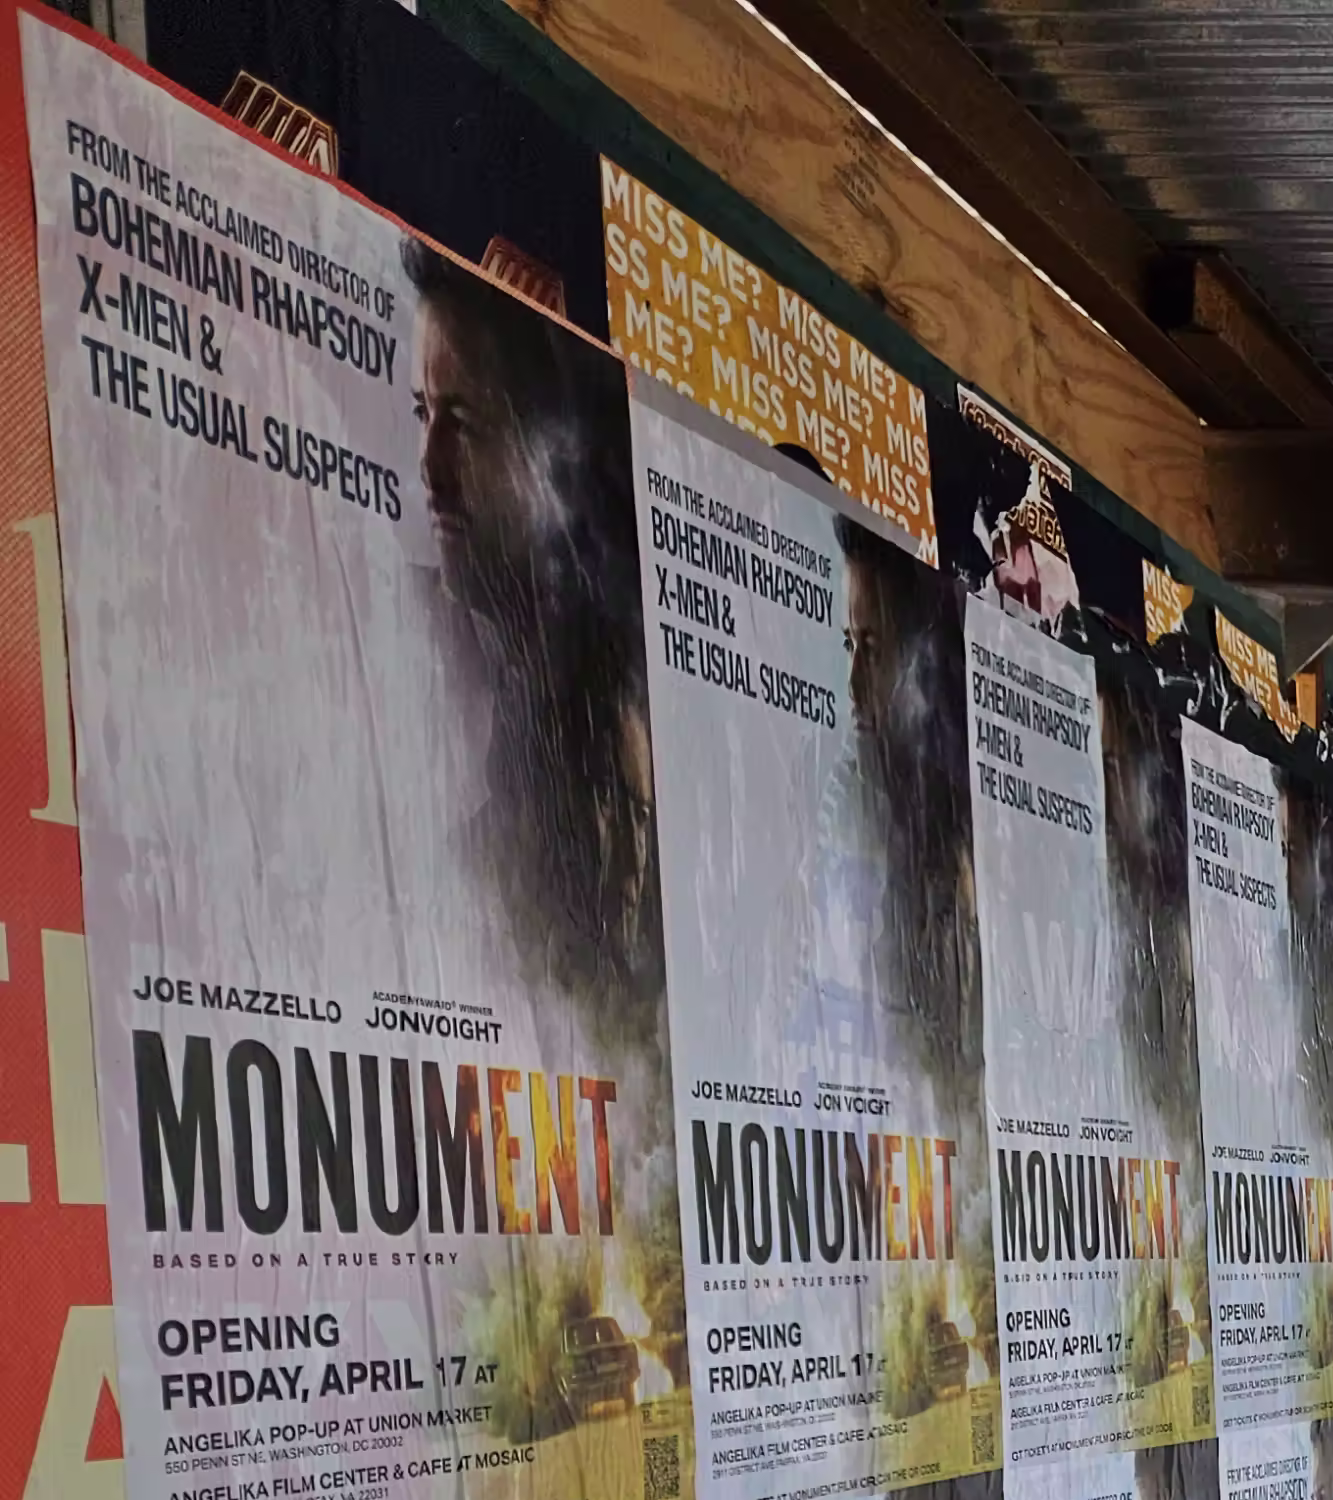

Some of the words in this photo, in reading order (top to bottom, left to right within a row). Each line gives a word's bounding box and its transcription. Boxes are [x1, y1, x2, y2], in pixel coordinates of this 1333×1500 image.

[66, 118, 131, 187] FROM
[135, 155, 171, 208] THE
[173, 175, 283, 266] ACCLAIMED
[288, 236, 369, 312] DIRECTOR
[373, 282, 395, 325] OF
[70, 169, 245, 316] BOHEMIAN
[250, 262, 400, 390] RHAPSODY
[602, 159, 688, 259] MISS
[699, 231, 762, 310] ME?
[778, 286, 841, 369] MISS
[850, 341, 897, 408] ME?
[75, 251, 191, 363] X-MEN
[196, 308, 224, 377] &
[661, 260, 731, 340] ME?
[747, 315, 816, 400] MISS
[823, 368, 874, 439] ME?
[81, 333, 152, 422] THE
[157, 366, 258, 465] USUAL
[261, 411, 401, 524] SUSPECTS
[625, 290, 694, 373] ME?
[711, 345, 788, 432] MISS
[795, 401, 850, 470] ME?
[862, 446, 921, 514] MISS
[650, 499, 748, 591] BOHEMIAN
[750, 549, 833, 631] RHAPSODY
[1142, 563, 1182, 614] MISS
[656, 561, 718, 631] X-MEN
[720, 591, 736, 639] &
[660, 621, 696, 677] THE
[699, 637, 756, 701] USUAL
[760, 663, 836, 732] SUSPECTS
[1222, 622, 1253, 665] MISS
[132, 972, 194, 1008] JOE
[198, 981, 342, 1026] MAZZELLO
[691, 1079, 723, 1103] JOE
[725, 1082, 802, 1110] MAZZELLO
[131, 1027, 619, 1238] MONUMENT
[691, 1117, 957, 1267] MONUMENT
[997, 1146, 1181, 1263] MONUMENT
[152, 1253, 237, 1269] BASED
[251, 1253, 283, 1268] ON
[296, 1253, 309, 1268] A
[323, 1253, 378, 1267] TRUE
[156, 1313, 340, 1357] OPENING
[706, 1320, 802, 1354] OPENING
[1005, 1306, 1070, 1332] OPENING
[1007, 1337, 1057, 1364] FRIDAY,
[1061, 1333, 1102, 1356] APRIL
[1106, 1331, 1120, 1352] 17
[160, 1365, 310, 1414] FRIDAY,
[318, 1358, 424, 1398] APRIL
[435, 1355, 468, 1387] 17
[474, 1364, 499, 1384] AT
[708, 1359, 786, 1396] FRIDAY,
[790, 1353, 846, 1383] APRIL
[163, 1427, 265, 1456] ANGELIKA
[269, 1419, 340, 1444] POP-UP
[342, 1417, 365, 1436] AT
[367, 1411, 423, 1433] UNION
[272, 1474, 316, 1498] FILM
[318, 1464, 389, 1491] CENTER
[392, 1463, 405, 1481] &
[406, 1457, 452, 1478] CAFE
[474, 1446, 536, 1470] MOSAIC
